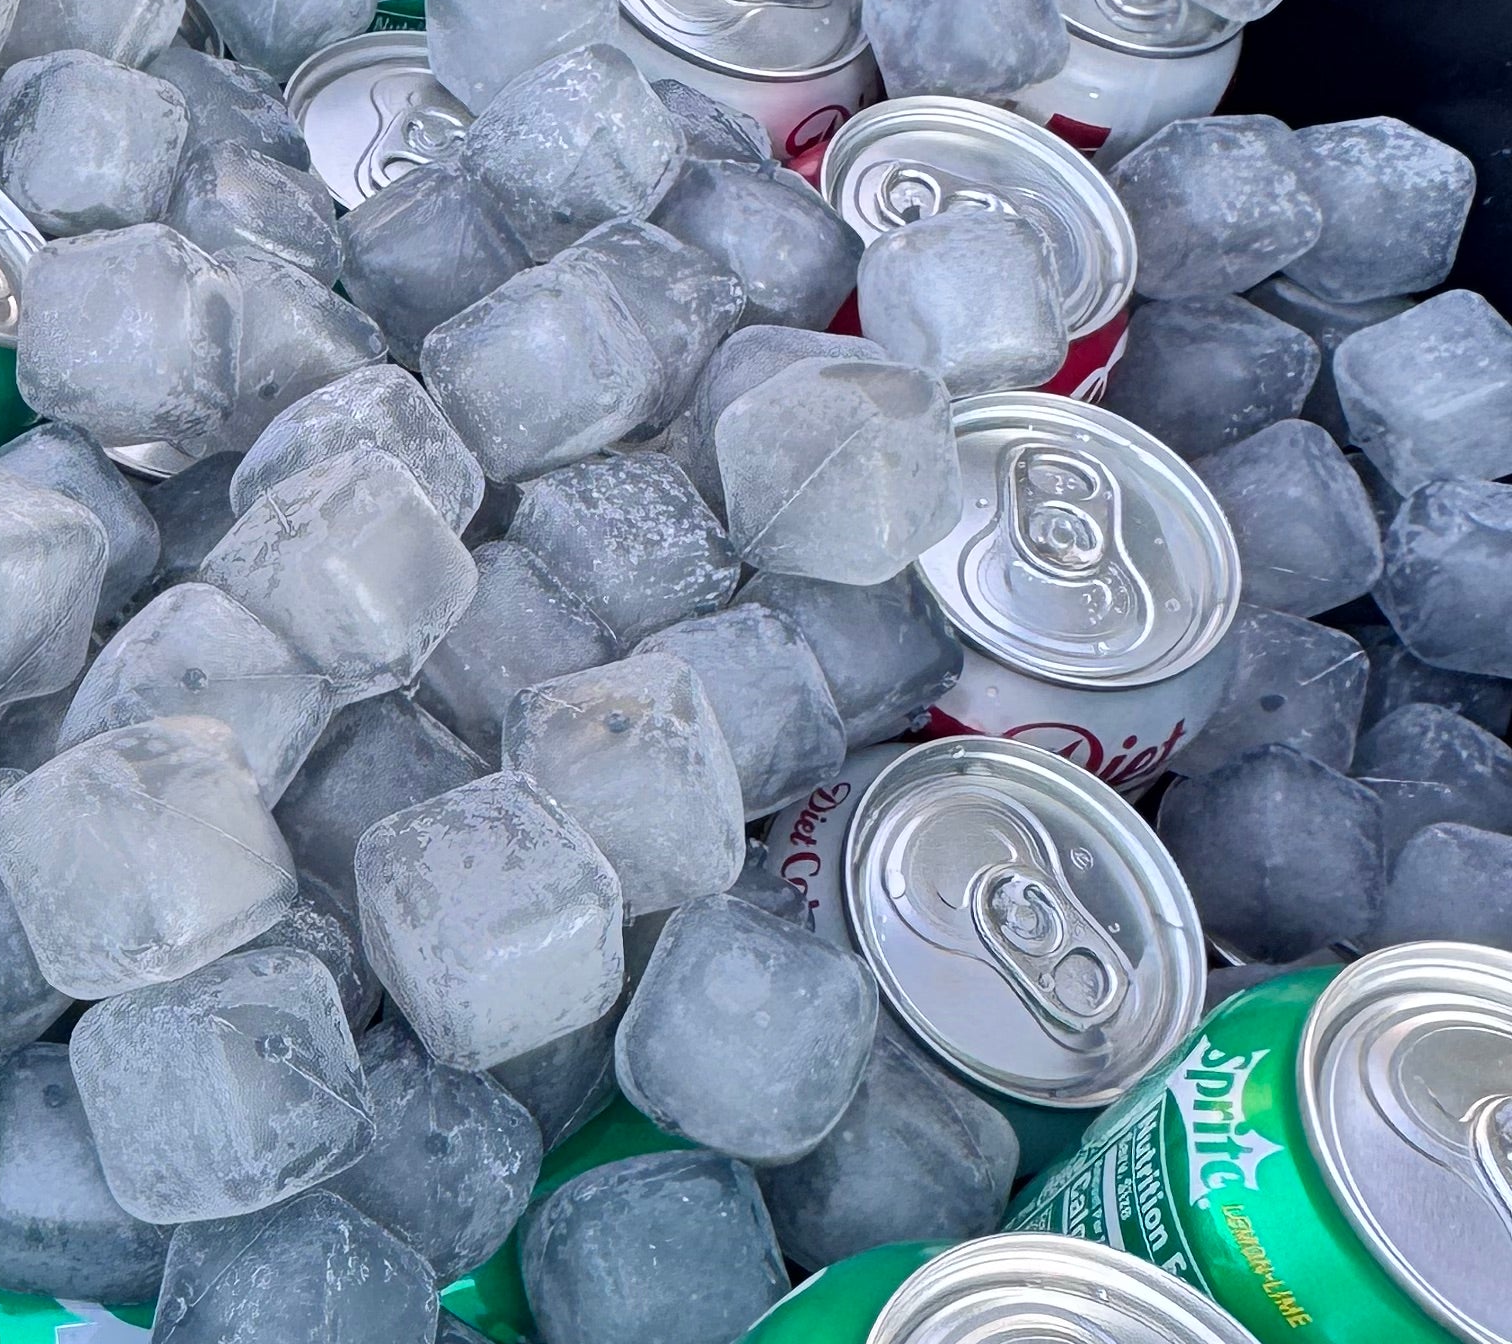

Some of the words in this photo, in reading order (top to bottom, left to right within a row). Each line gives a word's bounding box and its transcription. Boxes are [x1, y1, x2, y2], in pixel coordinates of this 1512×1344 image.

[789, 781, 852, 847] Diet
[1135, 1107, 1169, 1253] Nutrition
[1183, 1045, 1260, 1194] Sprite
[1221, 1202, 1314, 1330] LEMON-LIME
